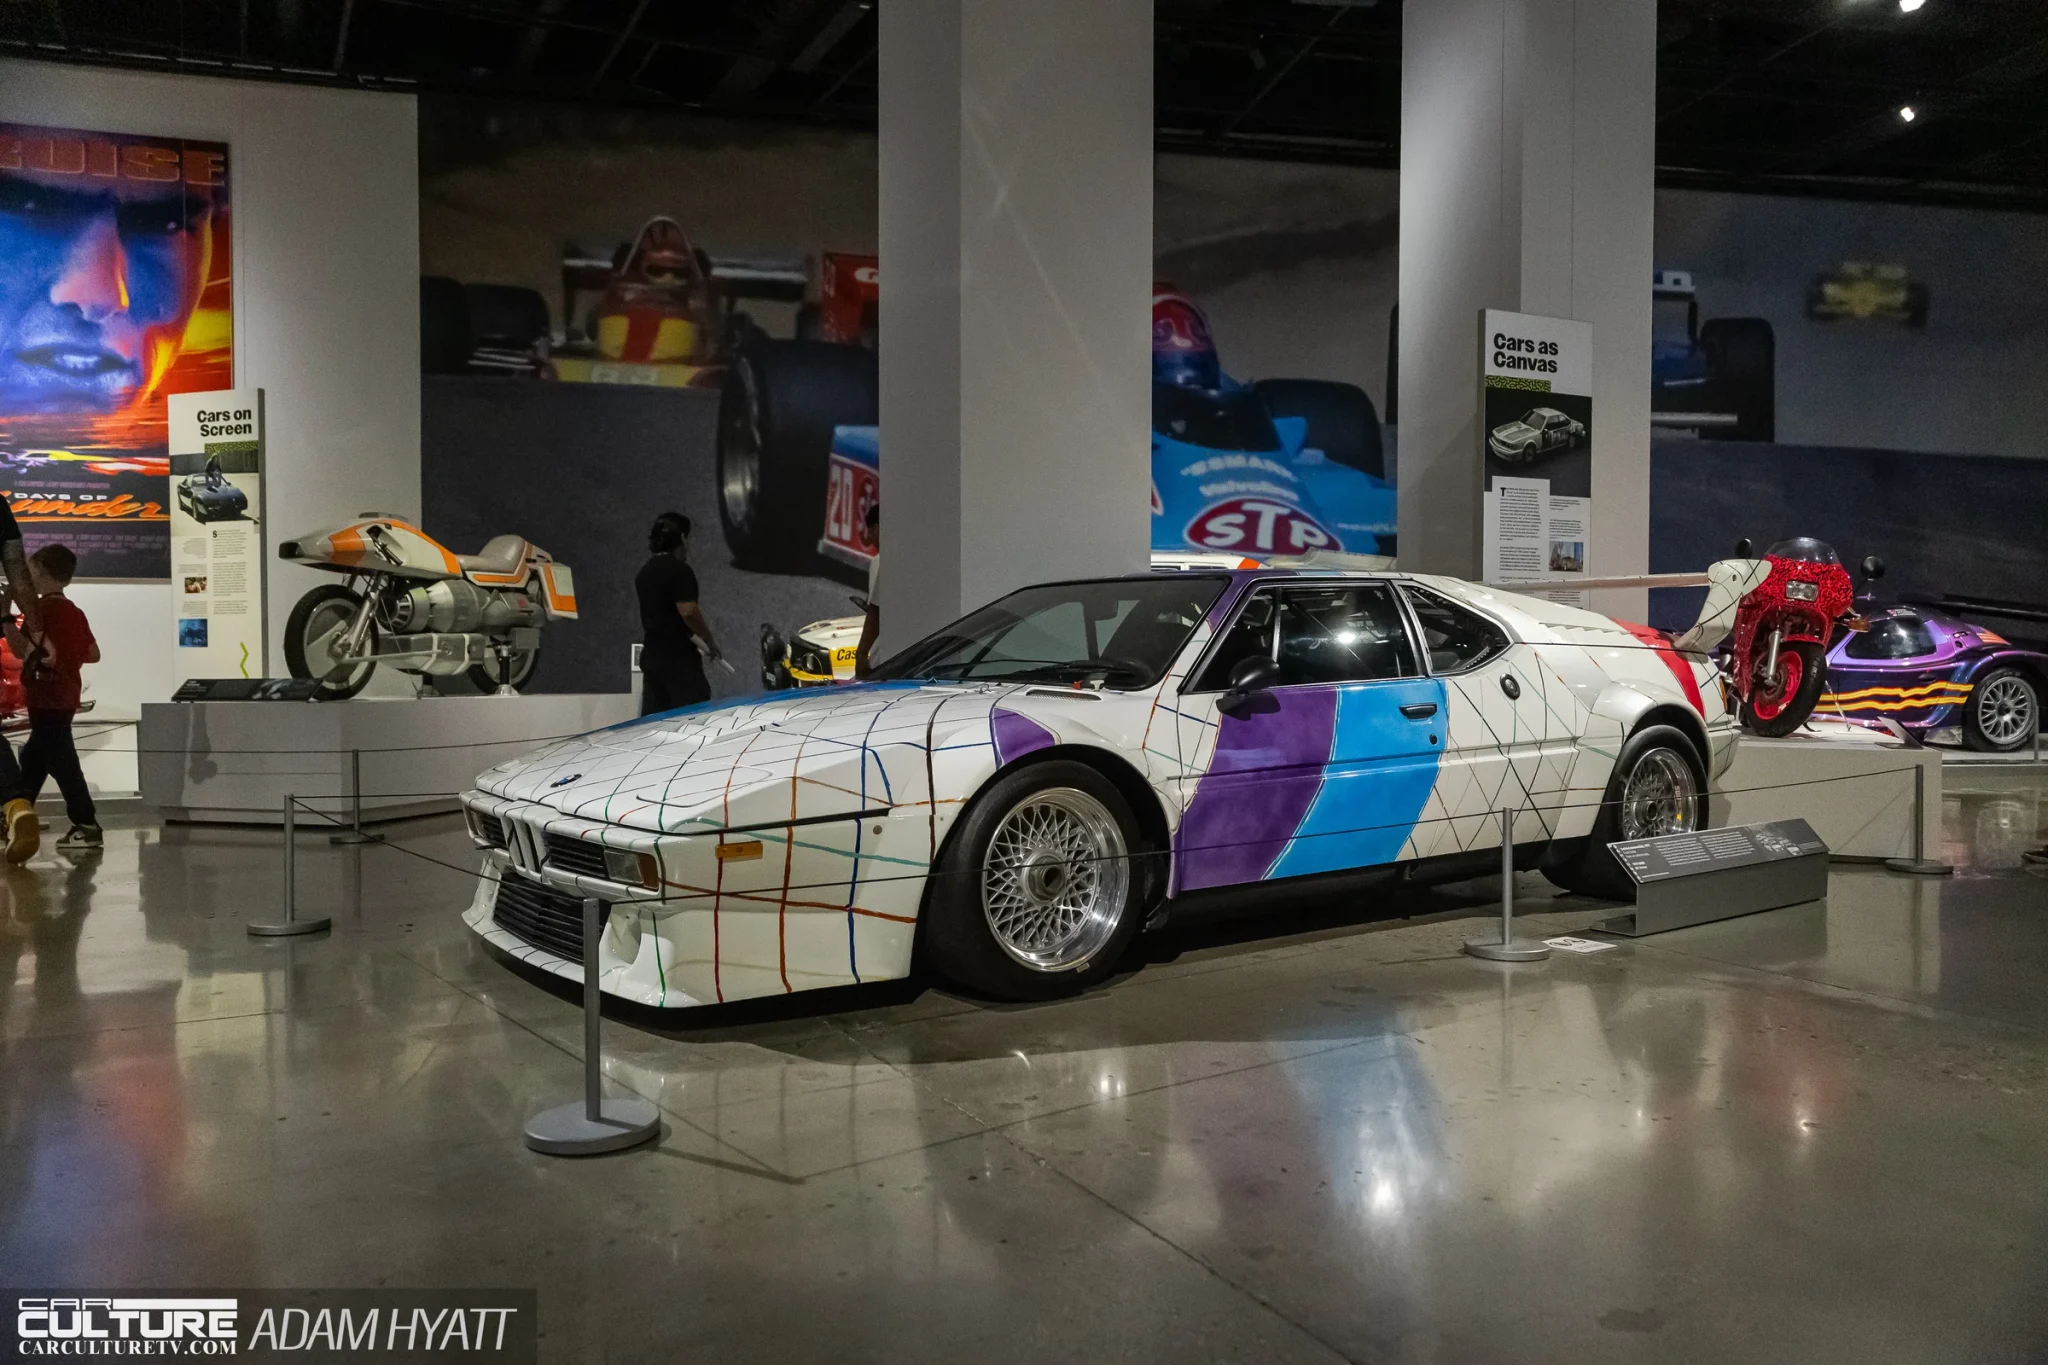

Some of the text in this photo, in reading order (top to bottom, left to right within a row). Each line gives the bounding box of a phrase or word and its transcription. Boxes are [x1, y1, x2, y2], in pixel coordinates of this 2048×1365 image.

[1493, 332, 1559, 356] Cars as
[1493, 351, 1558, 373] Canvas
[196, 408, 252, 423] Cars on
[200, 423, 252, 437] Screen
[14, 492, 71, 500] DAYS
[1203, 501, 1329, 551] STP
